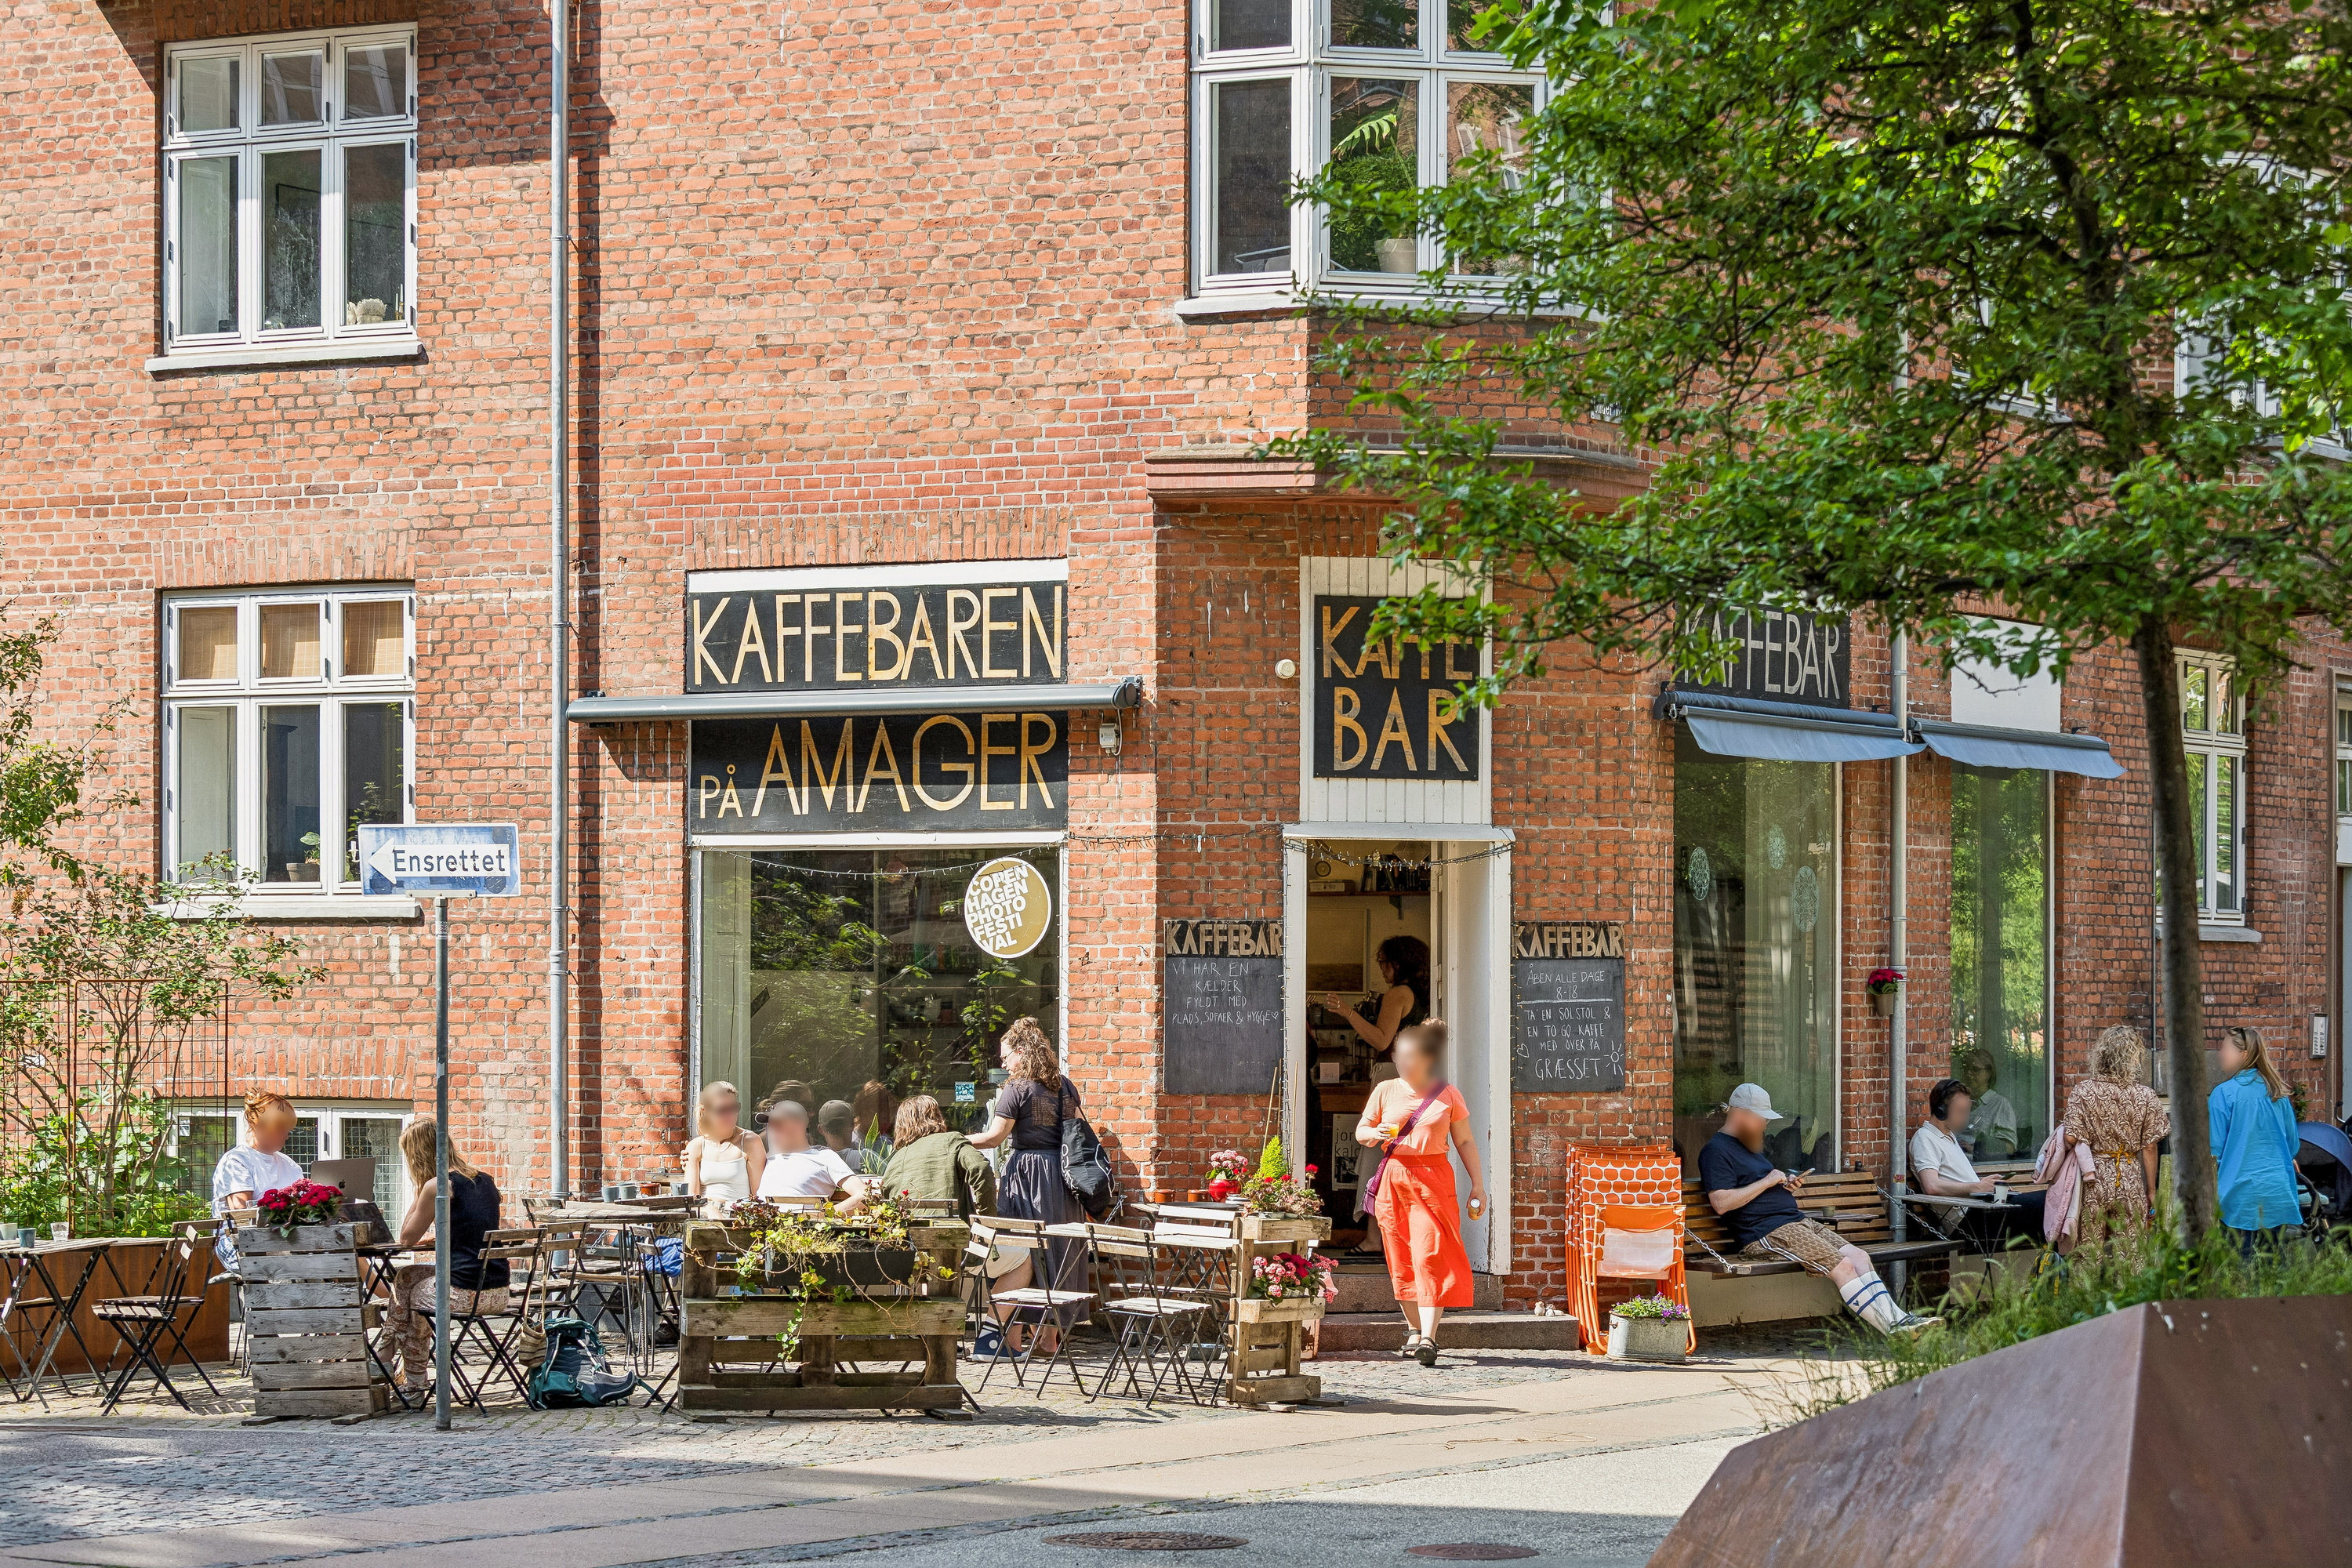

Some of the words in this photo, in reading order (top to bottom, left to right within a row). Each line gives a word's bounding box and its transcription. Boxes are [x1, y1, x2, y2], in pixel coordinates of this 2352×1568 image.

[693, 586, 1062, 684] KAFFEBAREN
[1334, 686, 1468, 771] BAR
[700, 764, 744, 818] PÅ
[751, 713, 1056, 816] AMAGER
[394, 850, 506, 872] Ensrettet
[969, 865, 1029, 896] COPEN
[968, 879, 1028, 913] HAGEN
[967, 895, 1026, 928] PHOTO
[974, 913, 1022, 940] FESTI
[1167, 924, 1283, 956] KAFFEBAR
[1513, 926, 1624, 957] KAFFEBAR
[1194, 962, 1221, 975] HAR
[1229, 962, 1249, 976] EN
[1526, 964, 1552, 985] ÅBEN
[1555, 972, 1577, 983] ALLE
[1581, 971, 1605, 982] DAGE
[1195, 980, 1241, 993] KÆLDER
[1186, 996, 1218, 1009] FYLDT
[1229, 996, 1247, 1008] MED
[1541, 1009, 1552, 1021] EN
[1604, 1006, 1610, 1019] &
[1236, 1011, 1243, 1024] &
[1247, 1010, 1271, 1026] HYGGE
[1527, 1026, 1537, 1037] EN
[1544, 1025, 1557, 1037] TO
[1561, 1024, 1571, 1038] GO
[1578, 1023, 1605, 1037] KAFFE
[1540, 1040, 1558, 1051] MED
[1565, 1039, 1585, 1051] OVER
[1588, 1038, 1600, 1051] PÅ
[1535, 1058, 1601, 1080] GRÆSSET
[1335, 1128, 1356, 1144] jor
